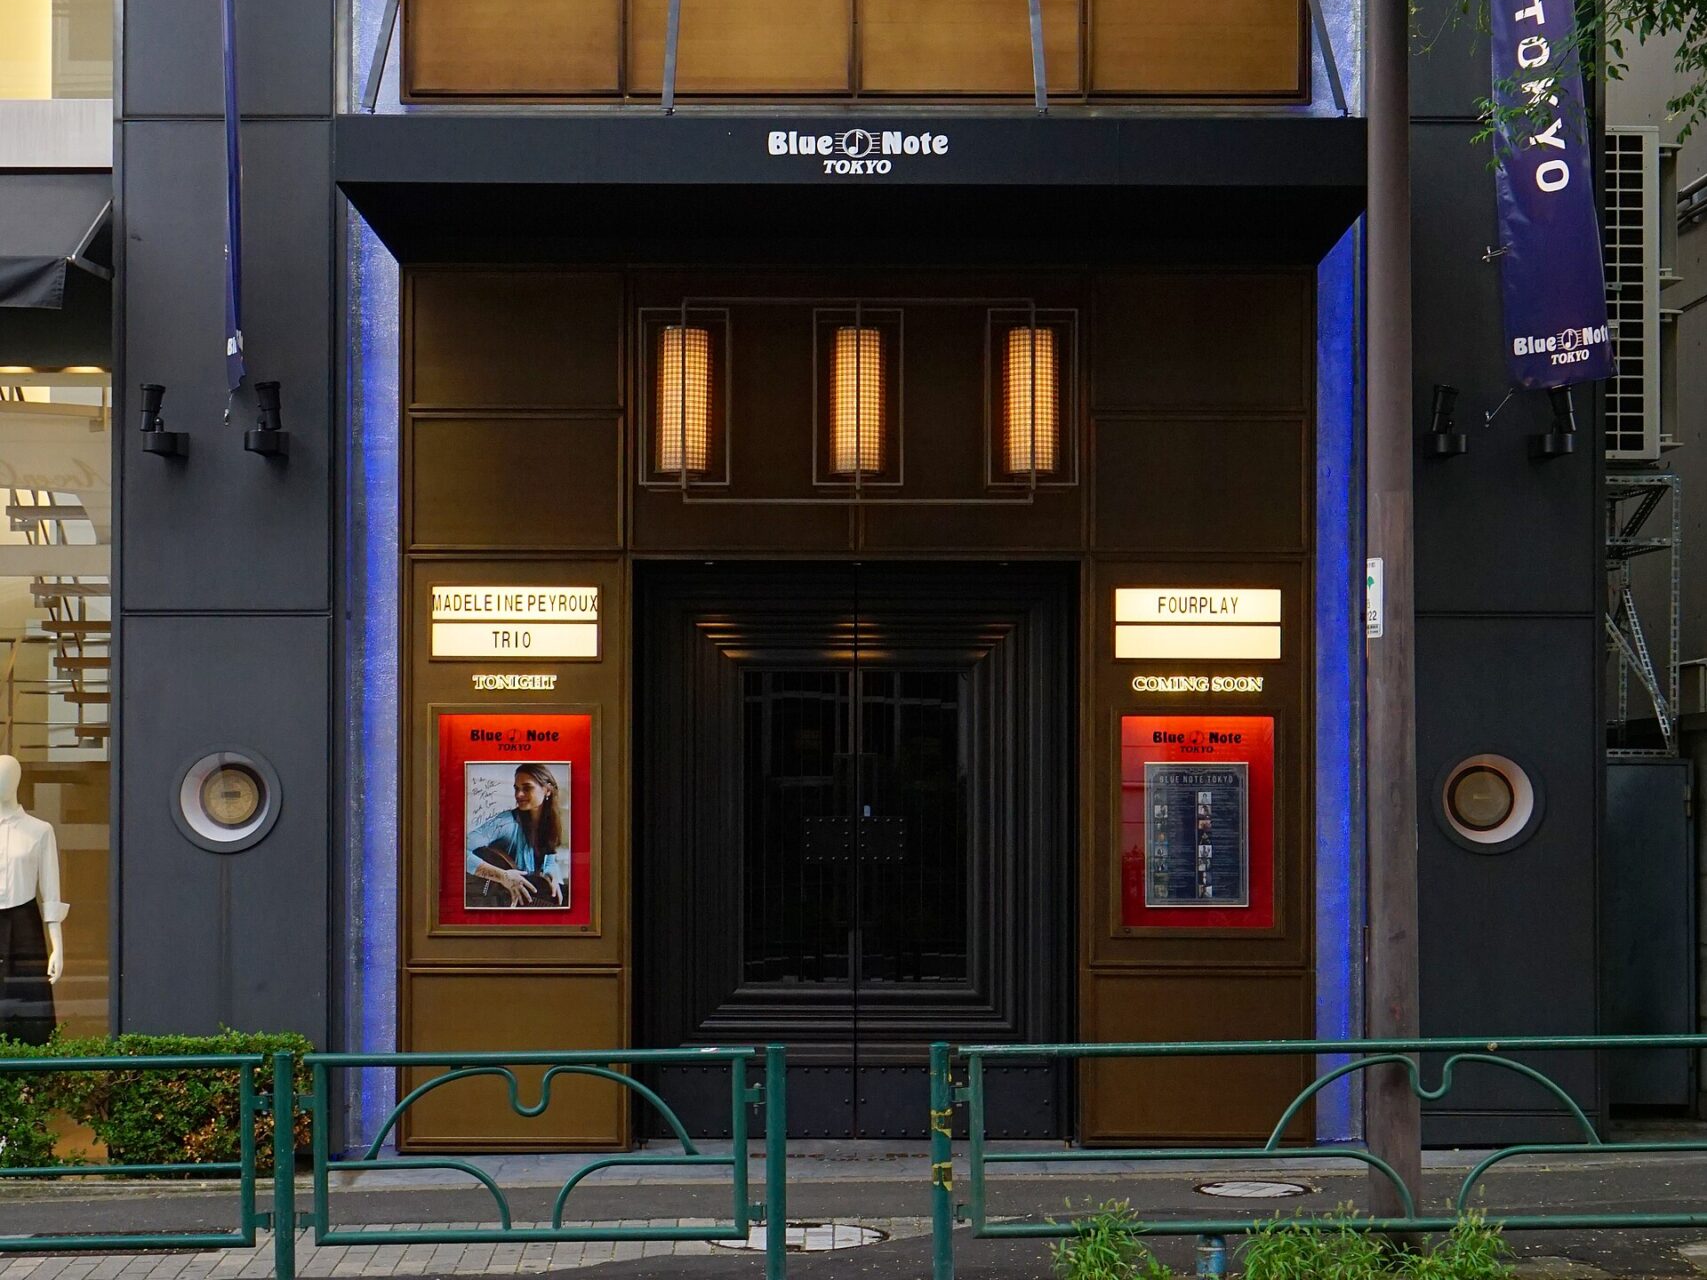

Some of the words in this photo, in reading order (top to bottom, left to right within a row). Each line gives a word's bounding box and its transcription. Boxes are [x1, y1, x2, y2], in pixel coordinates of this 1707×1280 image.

[768, 131, 833, 155] Blue
[882, 131, 948, 155] Note
[823, 160, 892, 174] TOKYO
[1513, 336, 1556, 356] Blue
[1551, 349, 1590, 365] TOKYO
[527, 594, 598, 612] PEYROUX
[1158, 596, 1239, 614] FOURPLAY
[492, 631, 531, 648] TRIO
[472, 674, 557, 690] TONIGHT
[1132, 676, 1210, 692] COMING
[1211, 676, 1263, 692] SOON
[470, 729, 502, 742] Blue
[526, 729, 559, 742] Note
[1153, 731, 1185, 744] Blue
[1209, 732, 1242, 744] Note
[498, 743, 532, 751] TOKYO
[1180, 745, 1214, 753] TOKYO
[1159, 775, 1179, 783] BLUE
[1182, 775, 1204, 783] NOTE
[1207, 775, 1234, 783] TOKYO
